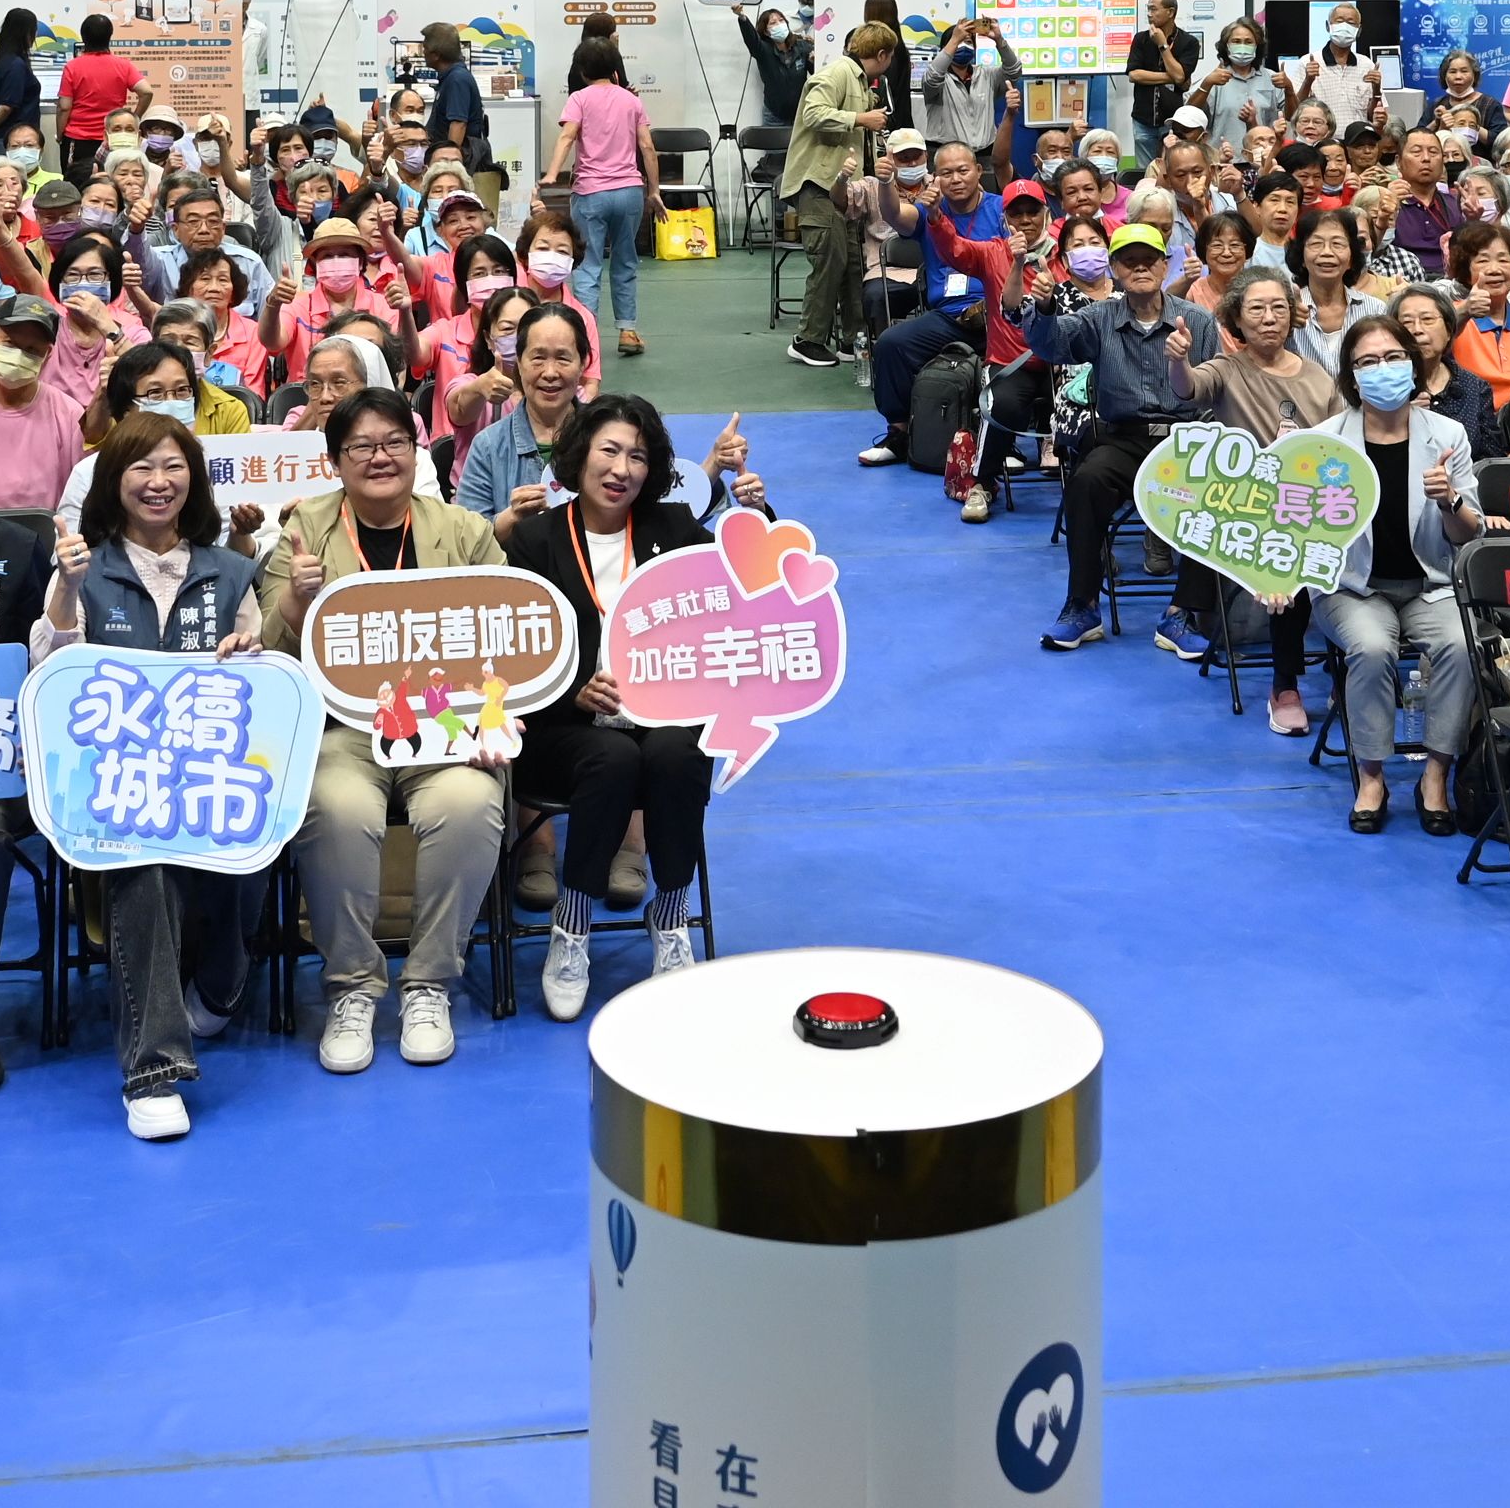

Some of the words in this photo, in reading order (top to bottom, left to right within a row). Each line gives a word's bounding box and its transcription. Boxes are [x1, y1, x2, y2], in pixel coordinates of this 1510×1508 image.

[1177, 427, 1282, 485] 70歲
[1204, 482, 1358, 527] 以上長者
[1177, 510, 1342, 584] 健保免費
[323, 600, 555, 668] 高齡友善城市
[620, 585, 732, 638] 臺東社福
[626, 621, 823, 688] 加倍幸福
[73, 663, 248, 756] 永續
[89, 753, 275, 836] 城市
[715, 1442, 759, 1508] 在
